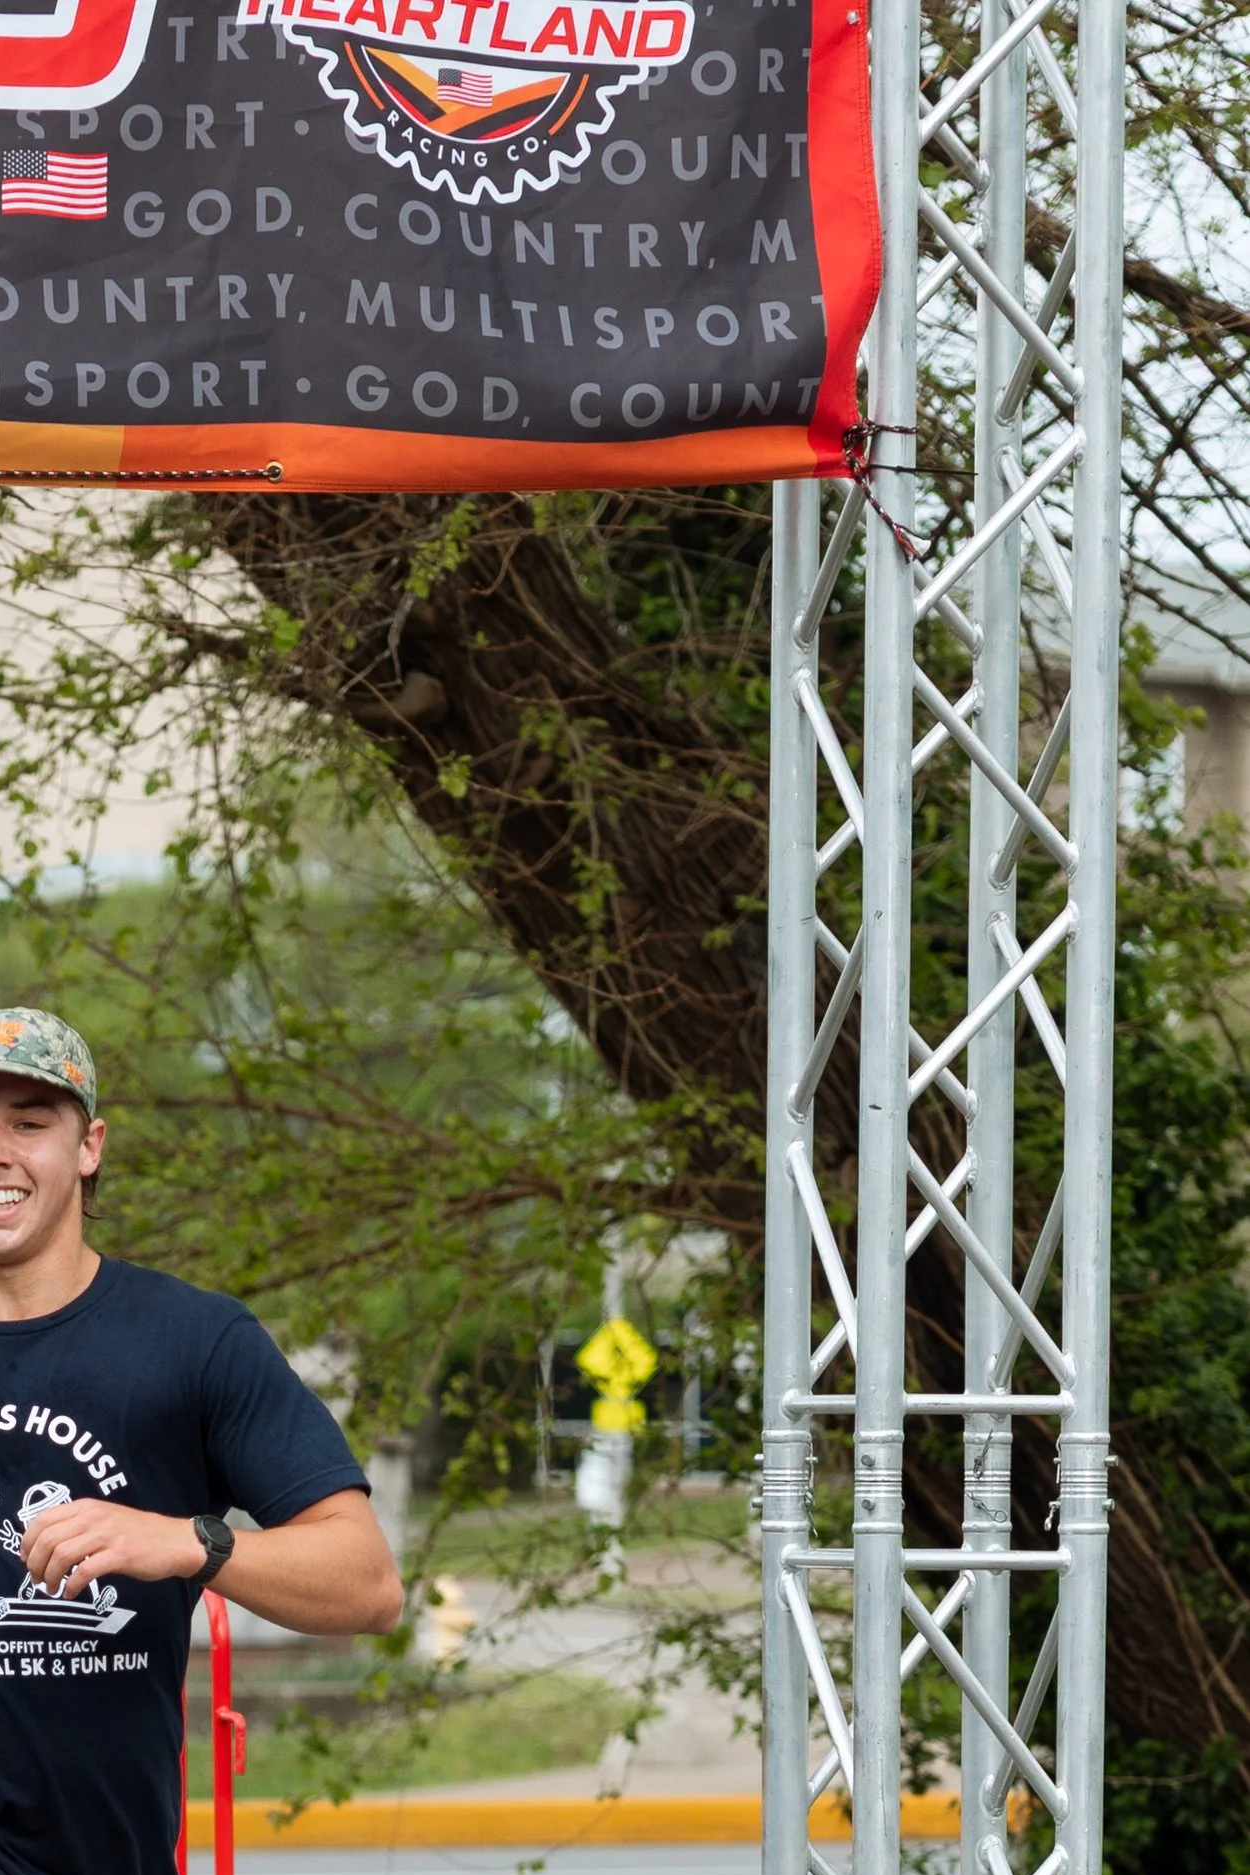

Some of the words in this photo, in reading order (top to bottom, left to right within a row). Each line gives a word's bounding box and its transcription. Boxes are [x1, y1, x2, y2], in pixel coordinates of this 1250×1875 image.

[387, 110, 488, 168] RACING
[507, 136, 548, 161] CO.
[559, 133, 807, 185] OUNT
[123, 187, 304, 238] GOD,
[344, 193, 716, 270] COUNTRY,
[750, 218, 798, 265] M
[346, 364, 530, 429] GOD,
[569, 376, 822, 428] COUNT
[24, 1405, 128, 1496] HOUSE
[20, 1657, 46, 1676] 5K
[51, 1658, 66, 1676] &
[71, 1655, 108, 1676] FUN
[113, 1651, 149, 1671] RUN
[49, 1639, 99, 1654] LEGACY
